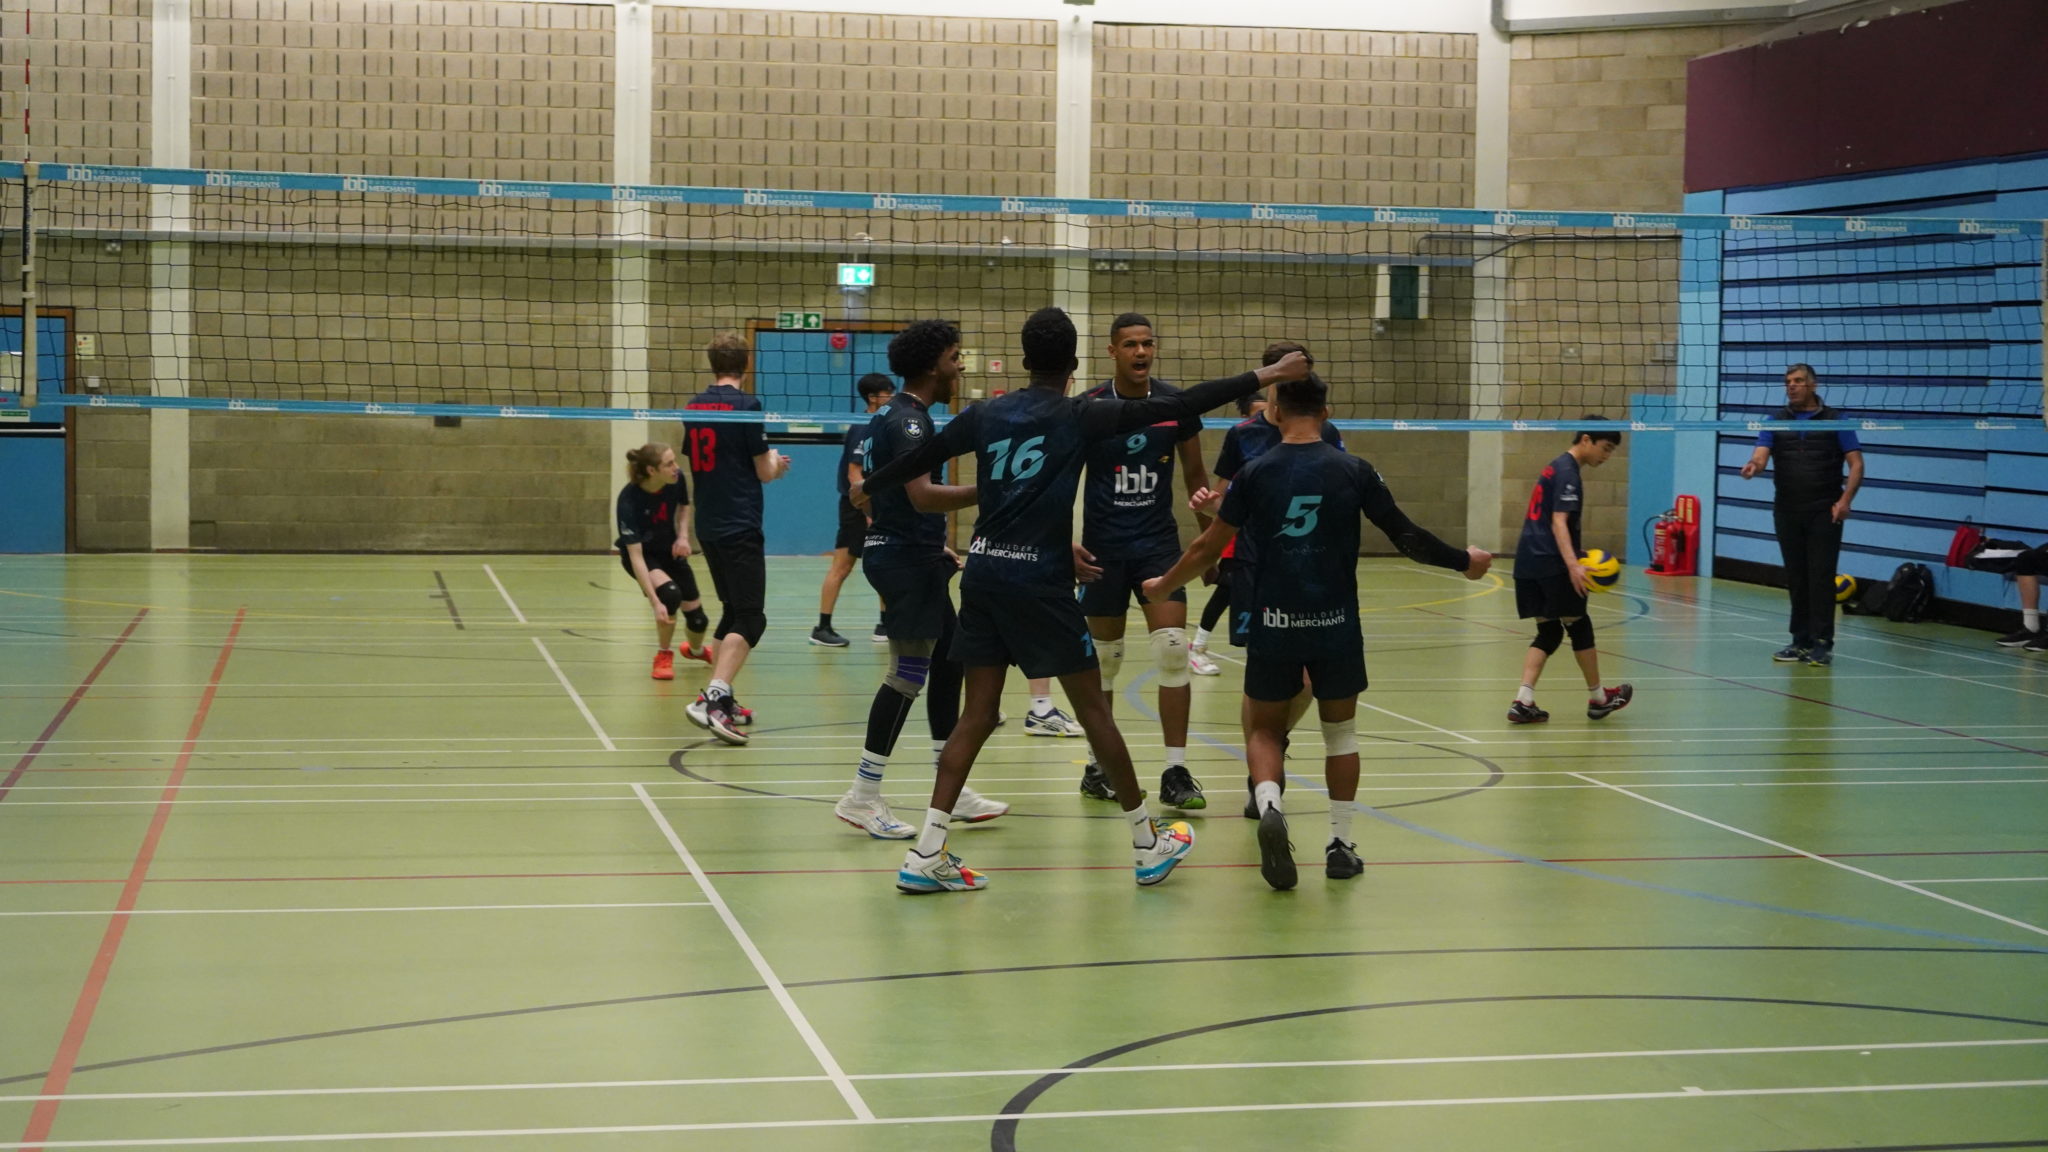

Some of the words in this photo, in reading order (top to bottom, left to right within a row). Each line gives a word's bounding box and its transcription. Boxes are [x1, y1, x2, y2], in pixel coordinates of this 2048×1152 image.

[67, 165, 92, 181] ibb
[206, 170, 231, 187] ibb
[343, 176, 368, 192] ibb
[479, 180, 502, 196] ibb
[612, 185, 636, 200] ibb
[744, 189, 767, 205] ibb
[873, 193, 896, 209] ibb
[1002, 197, 1024, 212] ibb
[1127, 201, 1149, 216] ibb
[1252, 204, 1274, 219] ibb
[1374, 207, 1396, 222] ibb
[1494, 210, 1516, 225] ibb
[1613, 213, 1635, 228] ibb
[1730, 216, 1750, 230] ibb
[1845, 217, 1866, 232] ibb
[1959, 219, 1979, 234] ibb
[689, 427, 716, 472] 13
[1126, 432, 1148, 455] 9
[987, 435, 1049, 482] 16
[1114, 464, 1158, 494] ibb
[1273, 495, 1323, 538] 5
[986, 547, 1038, 562] MERCHANTS
[1236, 611, 1252, 634] 2
[1263, 607, 1289, 628] ibb
[1290, 614, 1346, 628] MERCHANTS
